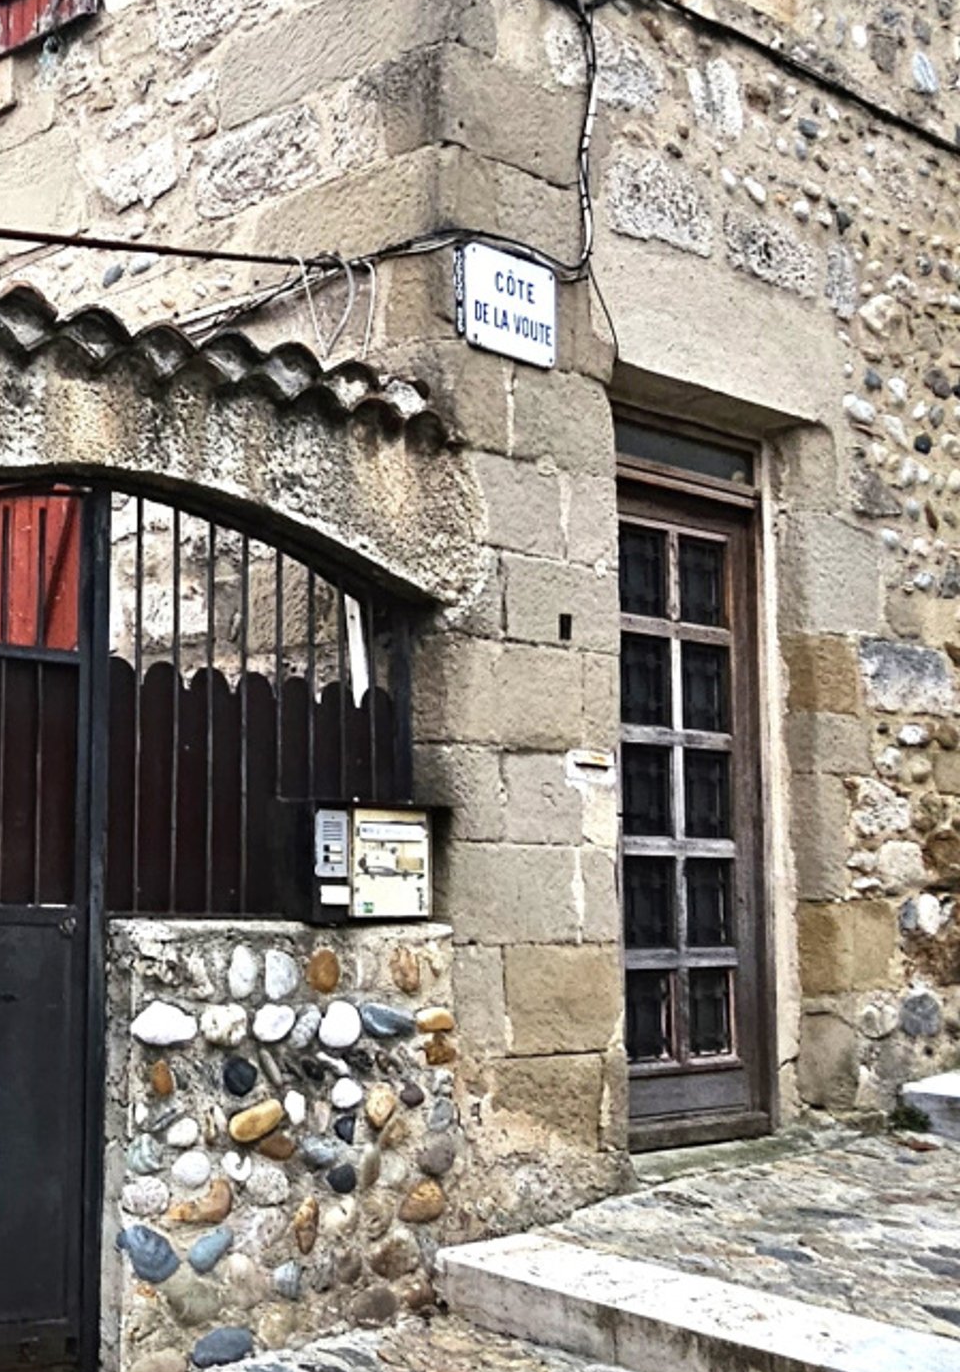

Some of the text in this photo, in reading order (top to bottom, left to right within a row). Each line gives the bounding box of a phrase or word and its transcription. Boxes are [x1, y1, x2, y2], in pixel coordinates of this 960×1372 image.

[495, 270, 535, 304] CÔTE
[475, 299, 552, 346] DE LA VOUTE
